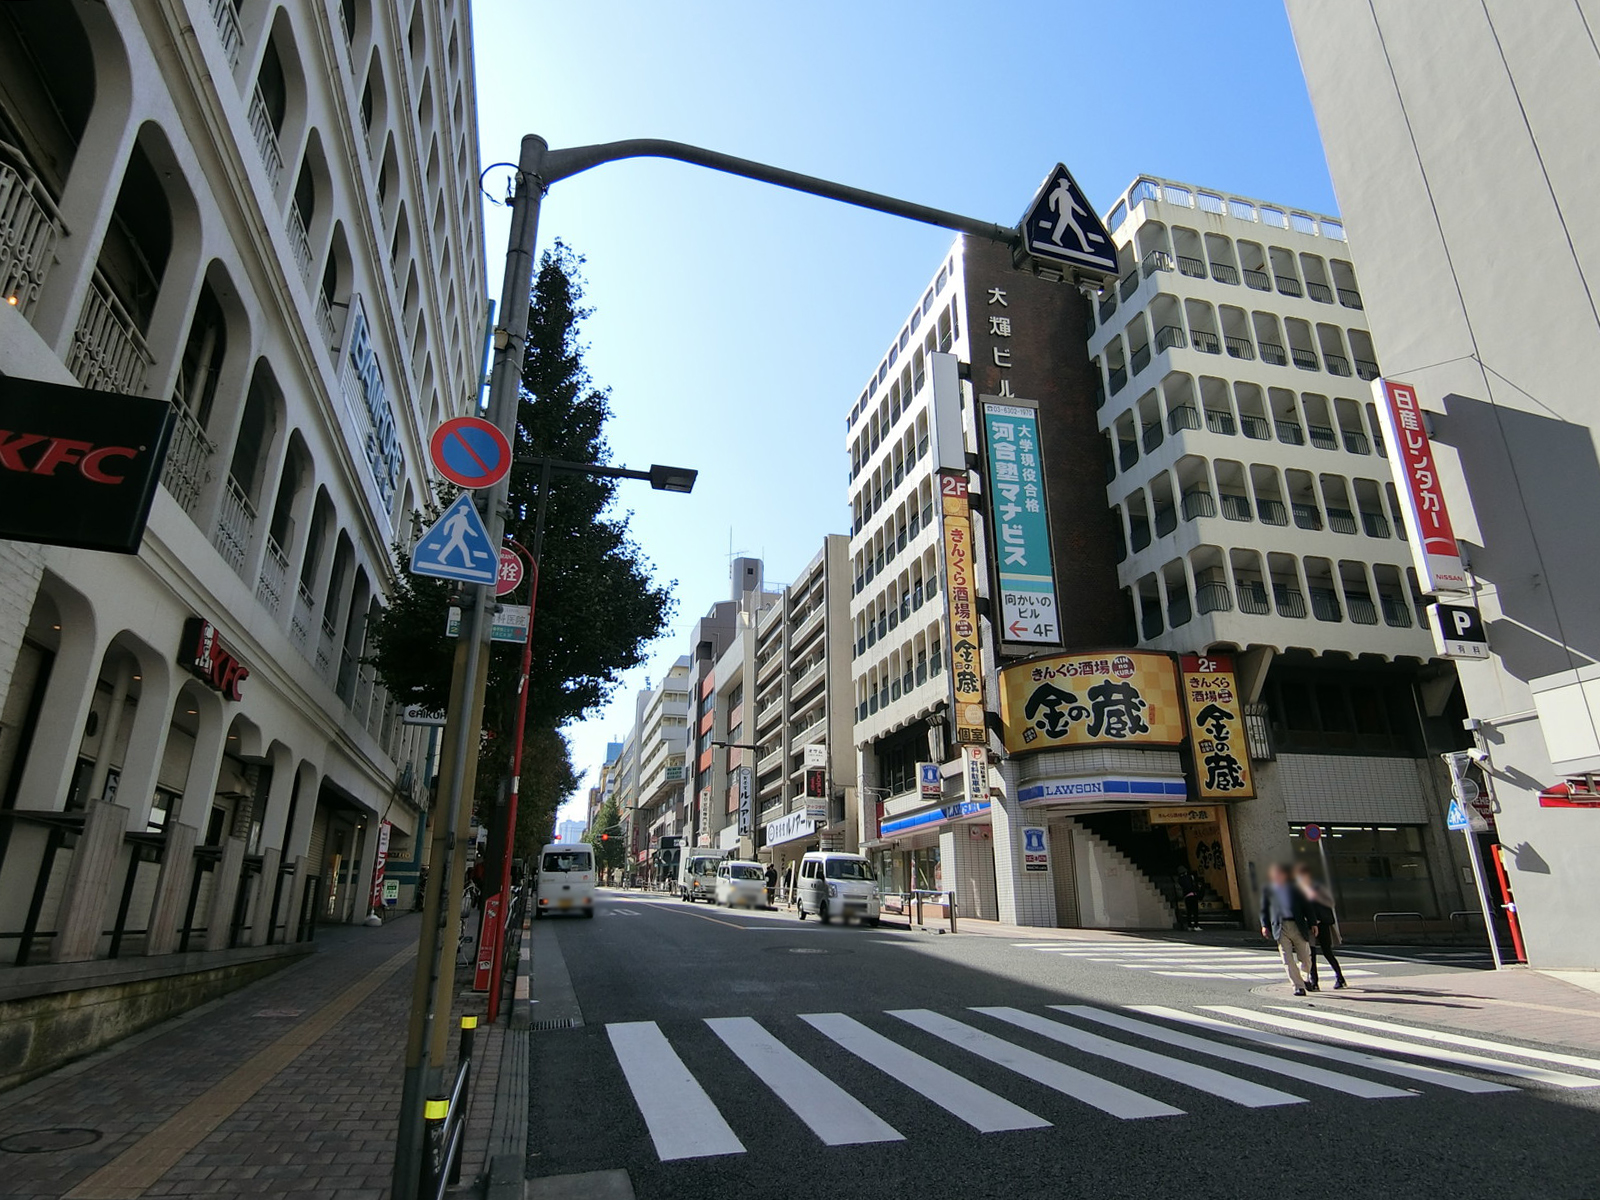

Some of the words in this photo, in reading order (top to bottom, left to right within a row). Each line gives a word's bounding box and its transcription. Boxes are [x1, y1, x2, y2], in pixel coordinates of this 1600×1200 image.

[988, 288, 1015, 398] 大輝ビル
[0, 430, 138, 485] KFC
[1393, 389, 1440, 528] 日産レンタカー
[1017, 424, 1040, 514] 大学現役合格
[943, 477, 966, 496] 2F
[991, 421, 1028, 567] 河合塾マナビス
[950, 528, 971, 619] きんくら酒場
[1436, 574, 1463, 582] NISSAN
[1004, 594, 1052, 608] 向かいの
[1018, 607, 1041, 620] ビル
[1033, 624, 1054, 638] 4F
[1453, 611, 1471, 636] P
[955, 639, 979, 694] 金の蔵
[1114, 656, 1129, 664] KIN
[1199, 658, 1217, 673] 2F
[213, 648, 249, 702] KFC
[1031, 660, 1110, 682] きんくら酒場
[1114, 668, 1135, 676] KURA
[1189, 677, 1230, 688] きんくら
[1192, 690, 1217, 703] 酒場
[1024, 680, 1149, 738] 金の蔵
[957, 727, 985, 743] 個室
[973, 750, 982, 759] P
[1197, 704, 1245, 791] 金の蔵
[970, 760, 981, 793] 有料駐車場
[1045, 782, 1102, 796] LAWSON
[946, 803, 980, 819] LAWSON
